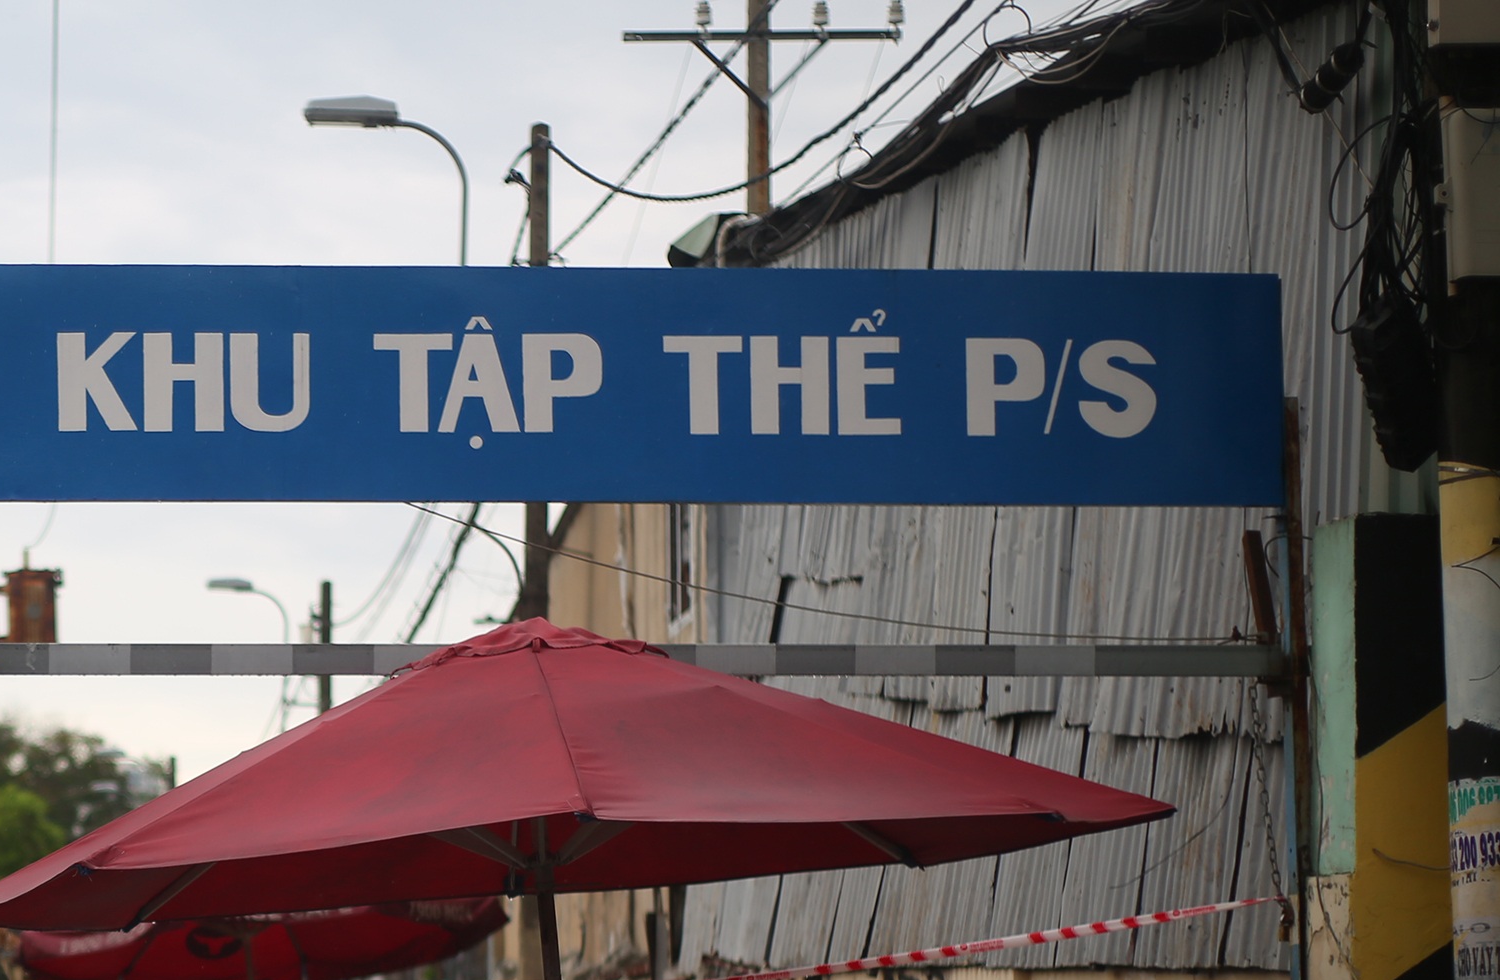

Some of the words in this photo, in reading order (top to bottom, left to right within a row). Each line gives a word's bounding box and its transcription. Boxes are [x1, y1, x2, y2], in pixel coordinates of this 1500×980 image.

[56, 332, 311, 433] KHU
[373, 316, 603, 450] TẬP
[663, 309, 902, 435] THỂ
[965, 338, 1157, 439] P/S
